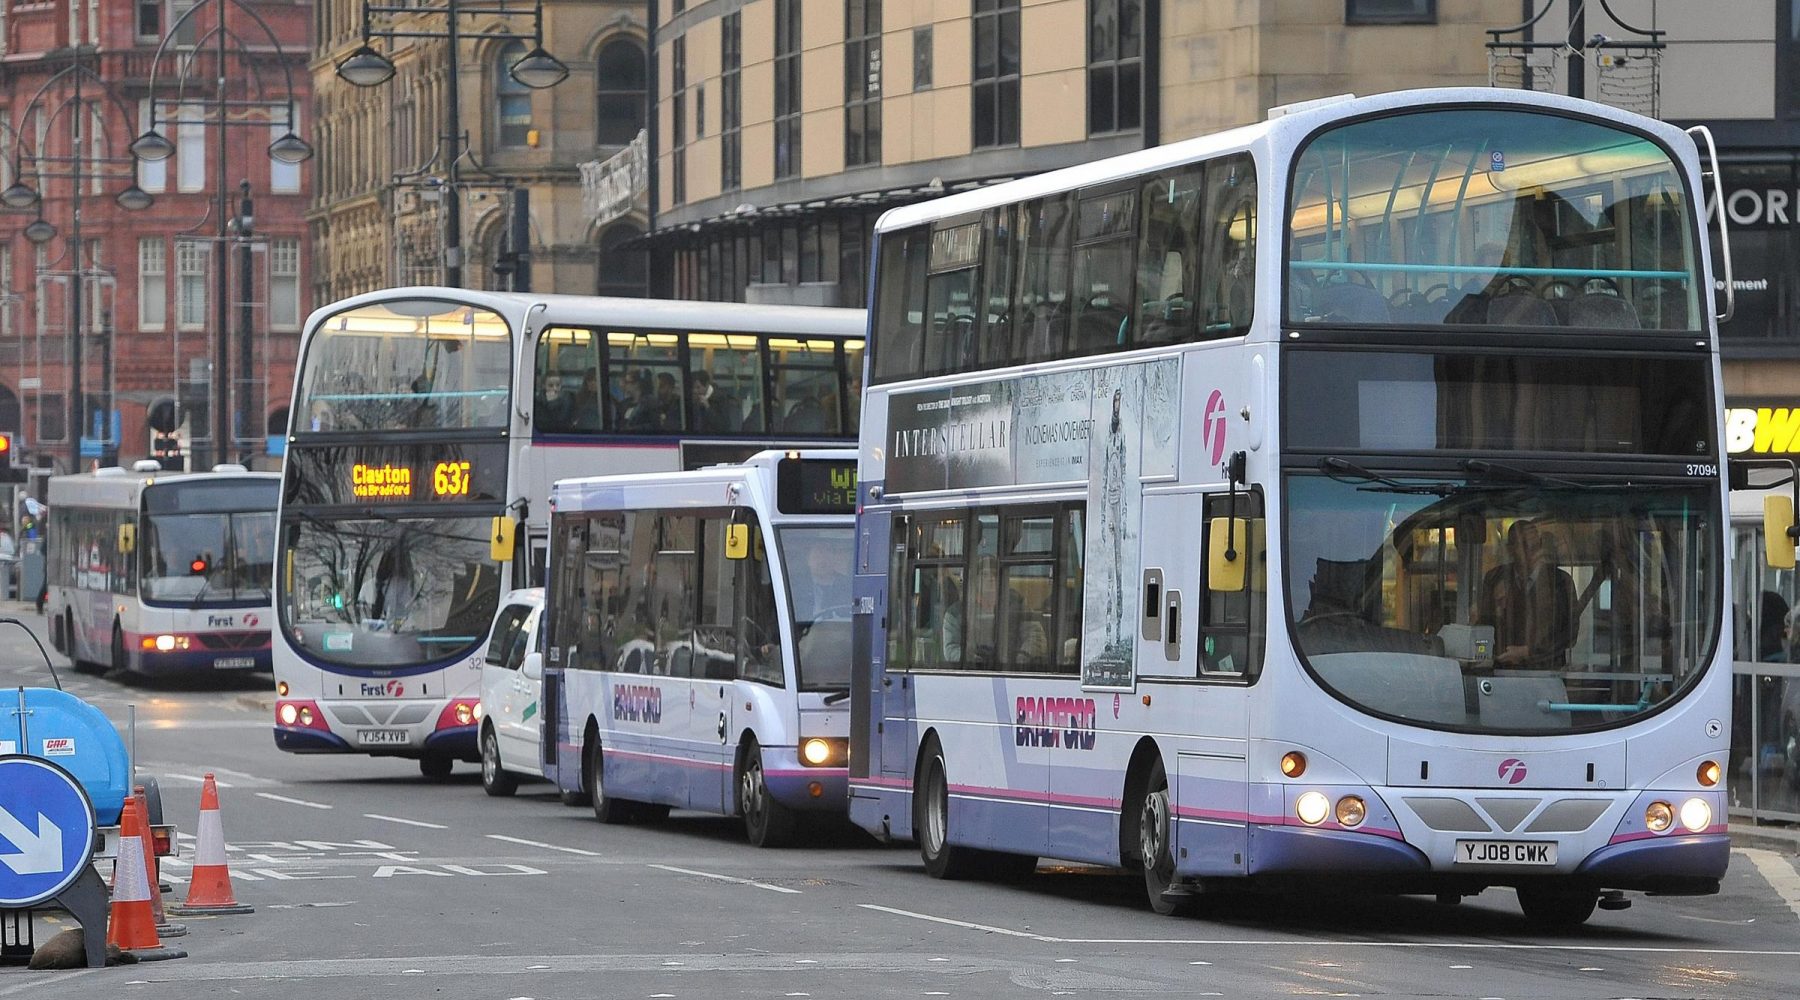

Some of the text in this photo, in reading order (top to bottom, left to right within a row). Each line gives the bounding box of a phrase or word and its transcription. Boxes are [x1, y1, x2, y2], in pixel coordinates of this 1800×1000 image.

[894, 420, 1006, 458] INTERSTELLAR
[1725, 407, 1800, 454] BW
[353, 461, 471, 495] Clayton 637
[1686, 464, 1717, 476] 37094
[207, 615, 234, 628] First
[361, 683, 386, 697] First
[614, 684, 662, 724] BRADFORD
[1016, 696, 1096, 751] BRADFORD
[46, 740, 68, 749] GAP
[362, 731, 386, 743] YJ54
[1464, 843, 1549, 862] YJ08 GWK
